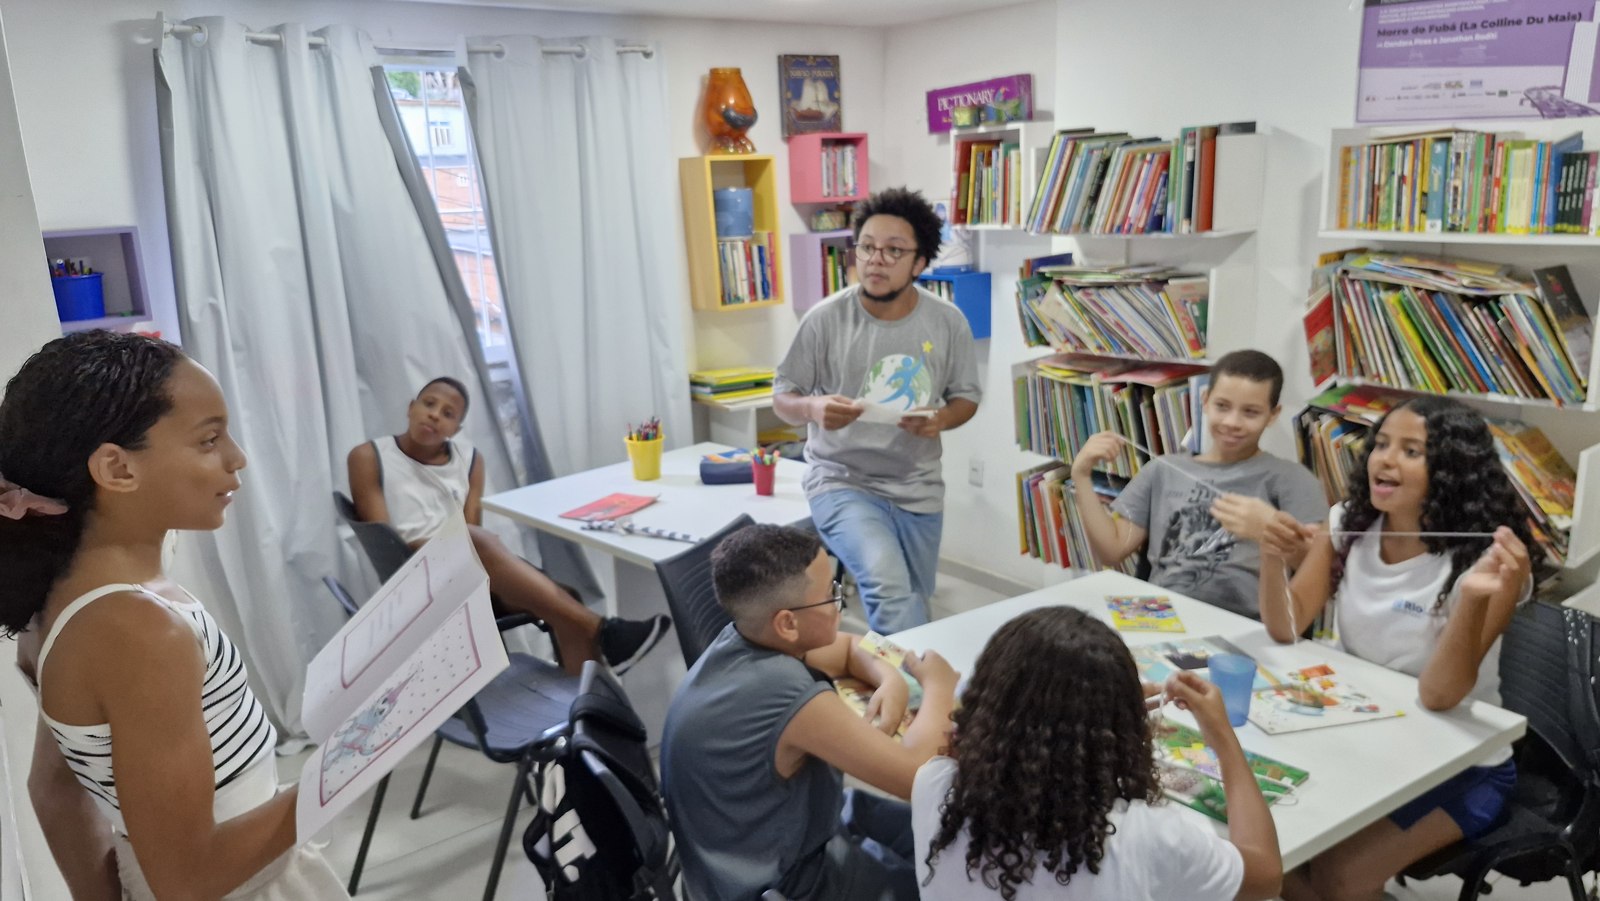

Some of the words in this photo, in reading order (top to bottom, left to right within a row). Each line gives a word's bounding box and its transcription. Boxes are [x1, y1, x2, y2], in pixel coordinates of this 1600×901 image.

[1377, 27, 1409, 38] Morro
[1411, 26, 1426, 35] do
[1429, 23, 1457, 33] Fubá
[1459, 21, 1478, 32] (La
[1480, 17, 1523, 30] Colline
[1526, 15, 1544, 26] Du
[1547, 12, 1583, 24] Mais)
[937, 89, 995, 112] PICTIONARY
[1404, 601, 1423, 613] Rio
